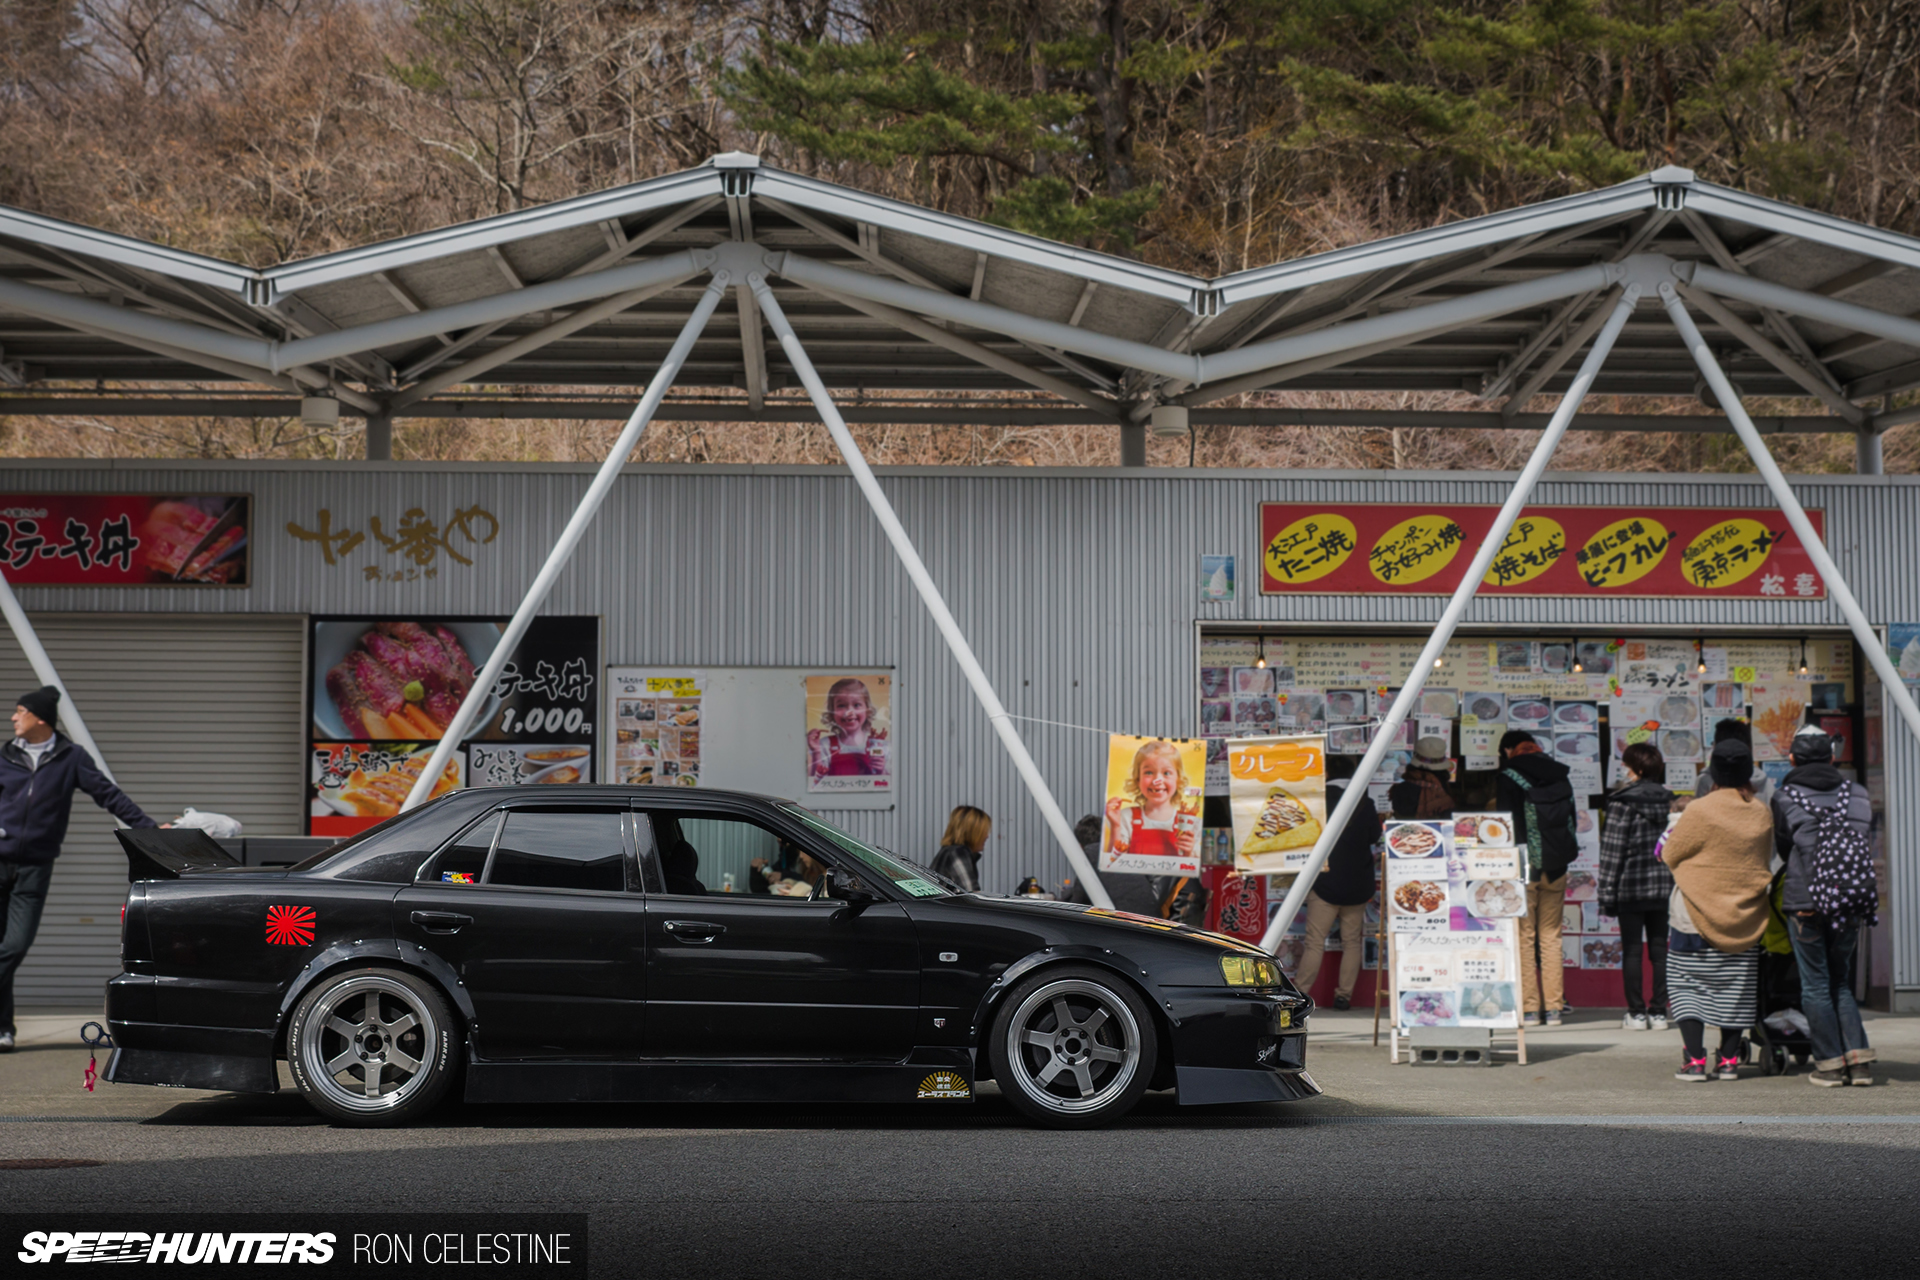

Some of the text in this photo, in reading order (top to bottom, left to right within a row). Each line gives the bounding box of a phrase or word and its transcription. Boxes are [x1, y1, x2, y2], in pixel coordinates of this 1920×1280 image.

[1268, 522, 1319, 560] 大江戸
[1278, 529, 1354, 579] たこ焼
[1369, 525, 1433, 562] チャンポン
[1376, 523, 1467, 581] お好み焼
[1492, 531, 1567, 586] 焼そば
[1494, 521, 1535, 555] 江戸
[1584, 530, 1678, 588] ビーフカレー
[472, 657, 594, 702] テーキ丼
[1239, 753, 1316, 775] クレープ
